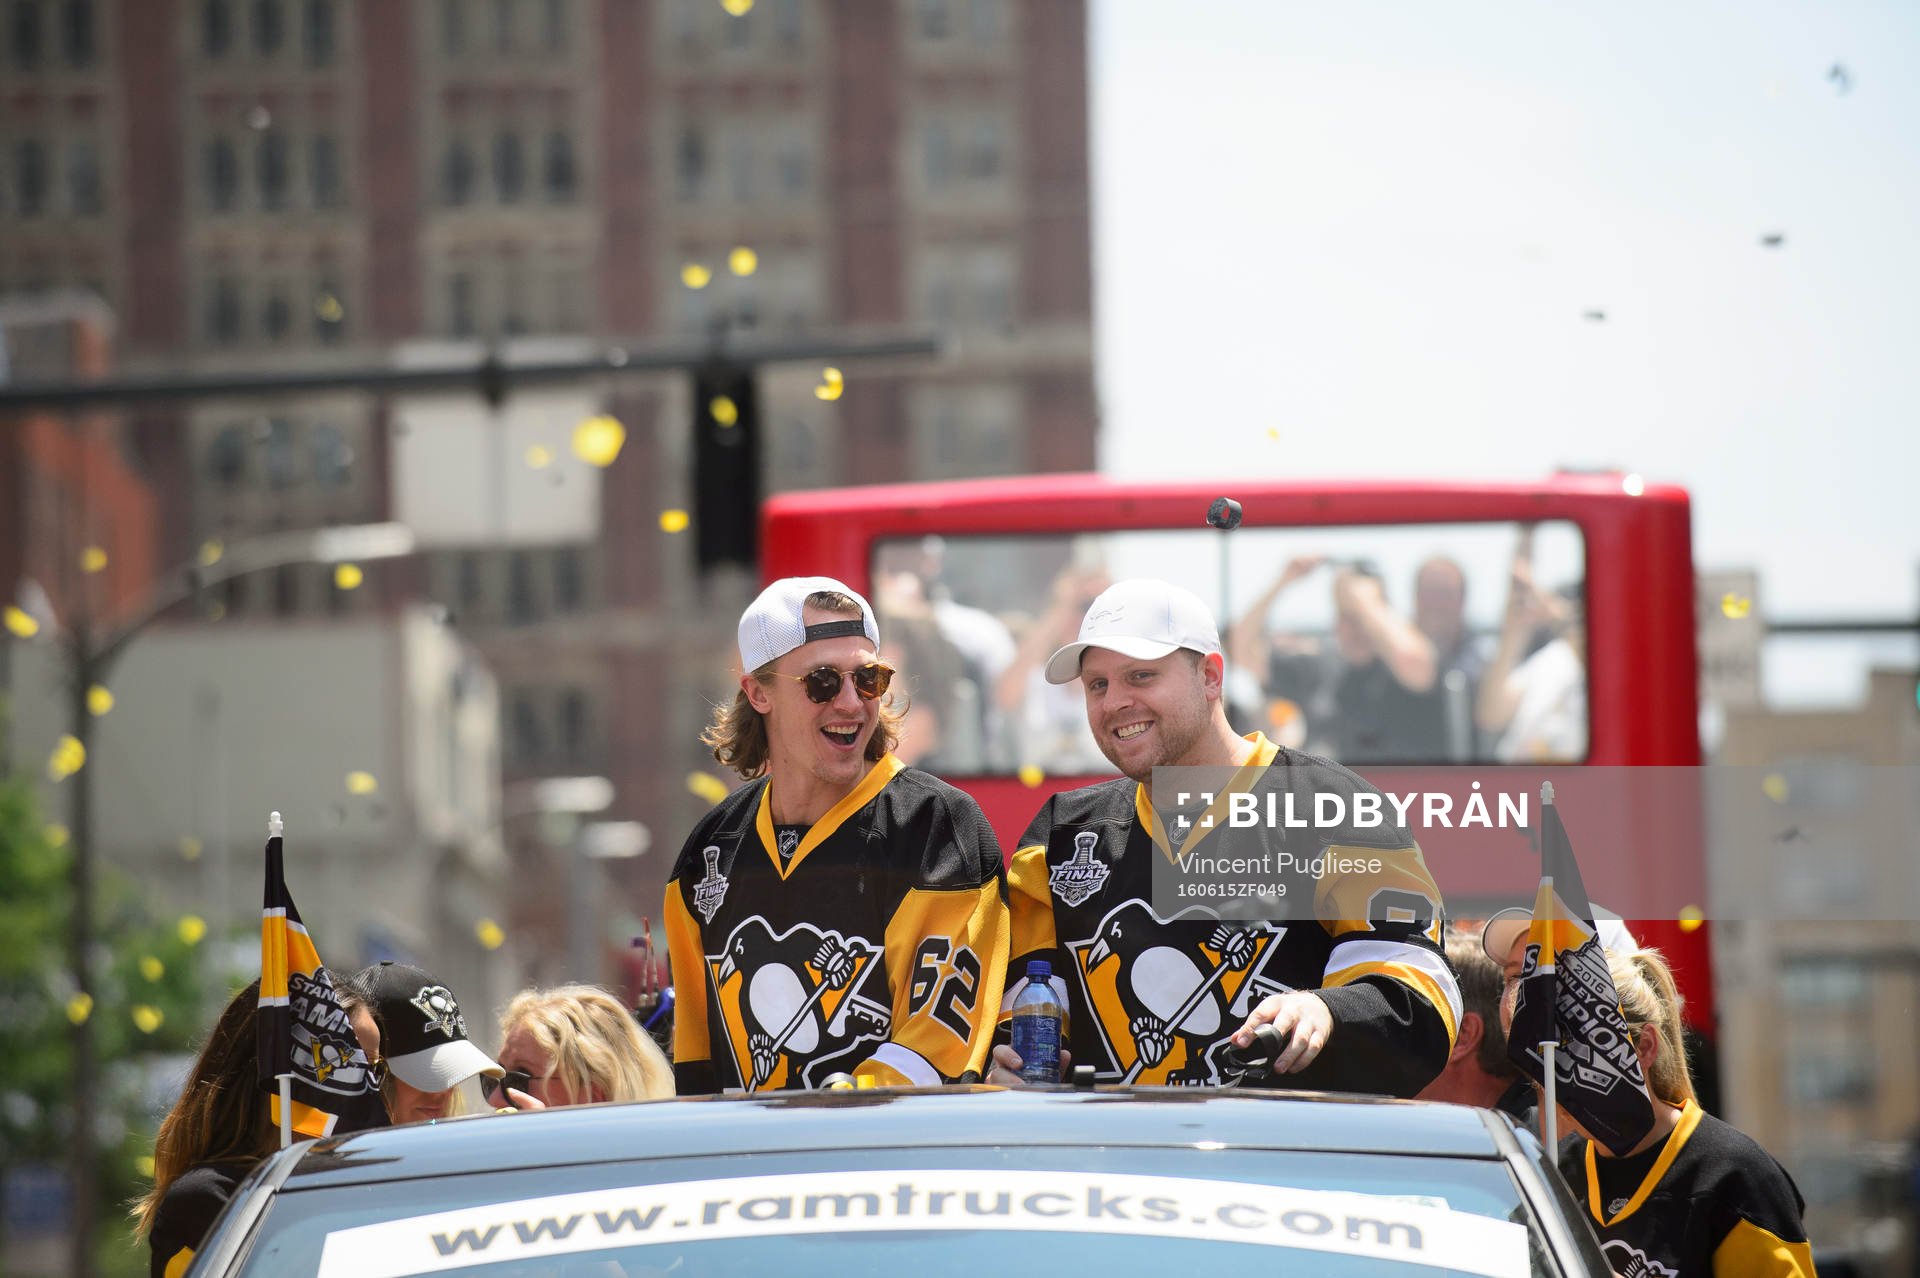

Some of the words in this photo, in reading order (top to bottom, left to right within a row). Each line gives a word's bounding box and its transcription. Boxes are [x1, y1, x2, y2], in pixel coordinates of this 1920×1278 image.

[698, 883, 725, 900] FINAL
[1055, 869, 1104, 881] FINAL
[908, 935, 982, 1047] 62
[1555, 963, 1597, 1004] ANLEY
[1594, 1003, 1629, 1035] CUP
[1573, 963, 1607, 994] 2016
[430, 1184, 1425, 1256] www.ramtrucks.com
